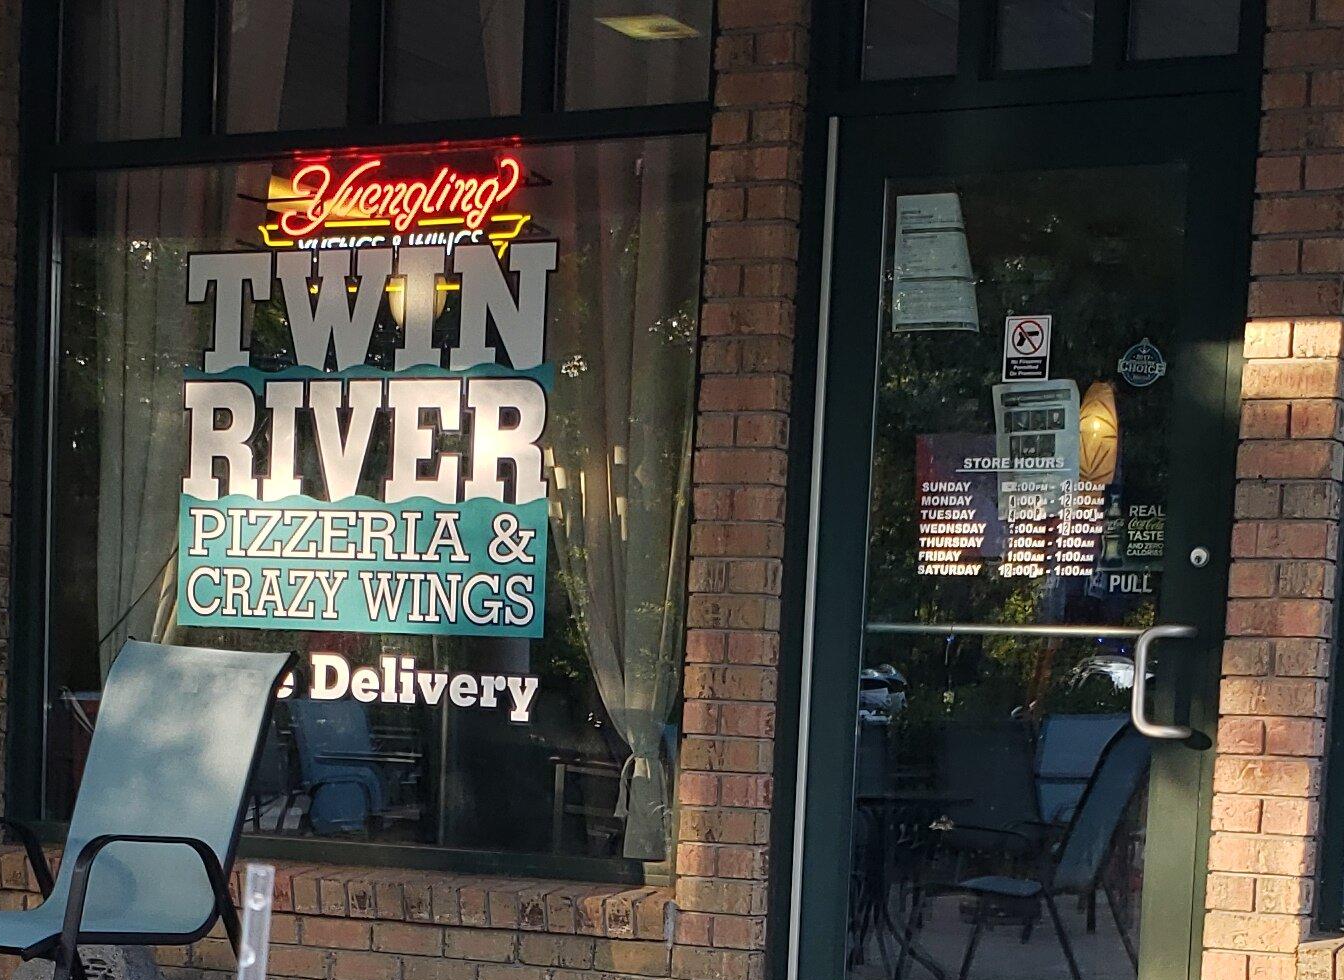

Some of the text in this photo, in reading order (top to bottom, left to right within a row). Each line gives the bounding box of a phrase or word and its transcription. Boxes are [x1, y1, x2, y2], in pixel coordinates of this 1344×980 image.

[280, 156, 521, 237] Yuengling
[187, 241, 558, 373] TWIN
[181, 376, 549, 503] RIVER
[963, 456, 1065, 469] STORE HOURS
[921, 481, 971, 492] SUNDAY
[921, 495, 973, 506] MONDAY
[920, 509, 976, 520] TUESDAY
[1129, 505, 1166, 516] REAL
[919, 523, 986, 534] WEDNSDAY
[187, 508, 537, 565] PIZZERIA &
[1127, 531, 1164, 541] TASTE
[918, 537, 985, 548] THURSDAY
[1056, 537, 1094, 548] 1:00AM
[918, 551, 962, 561] FRIDAY
[1055, 550, 1094, 561] 1:00AM
[917, 565, 982, 575] SATURDAY
[1054, 564, 1093, 576] 1:00AM
[1108, 573, 1153, 593] PULL
[186, 565, 536, 627] CRAZY WINGS
[309, 652, 539, 722] Delivery
